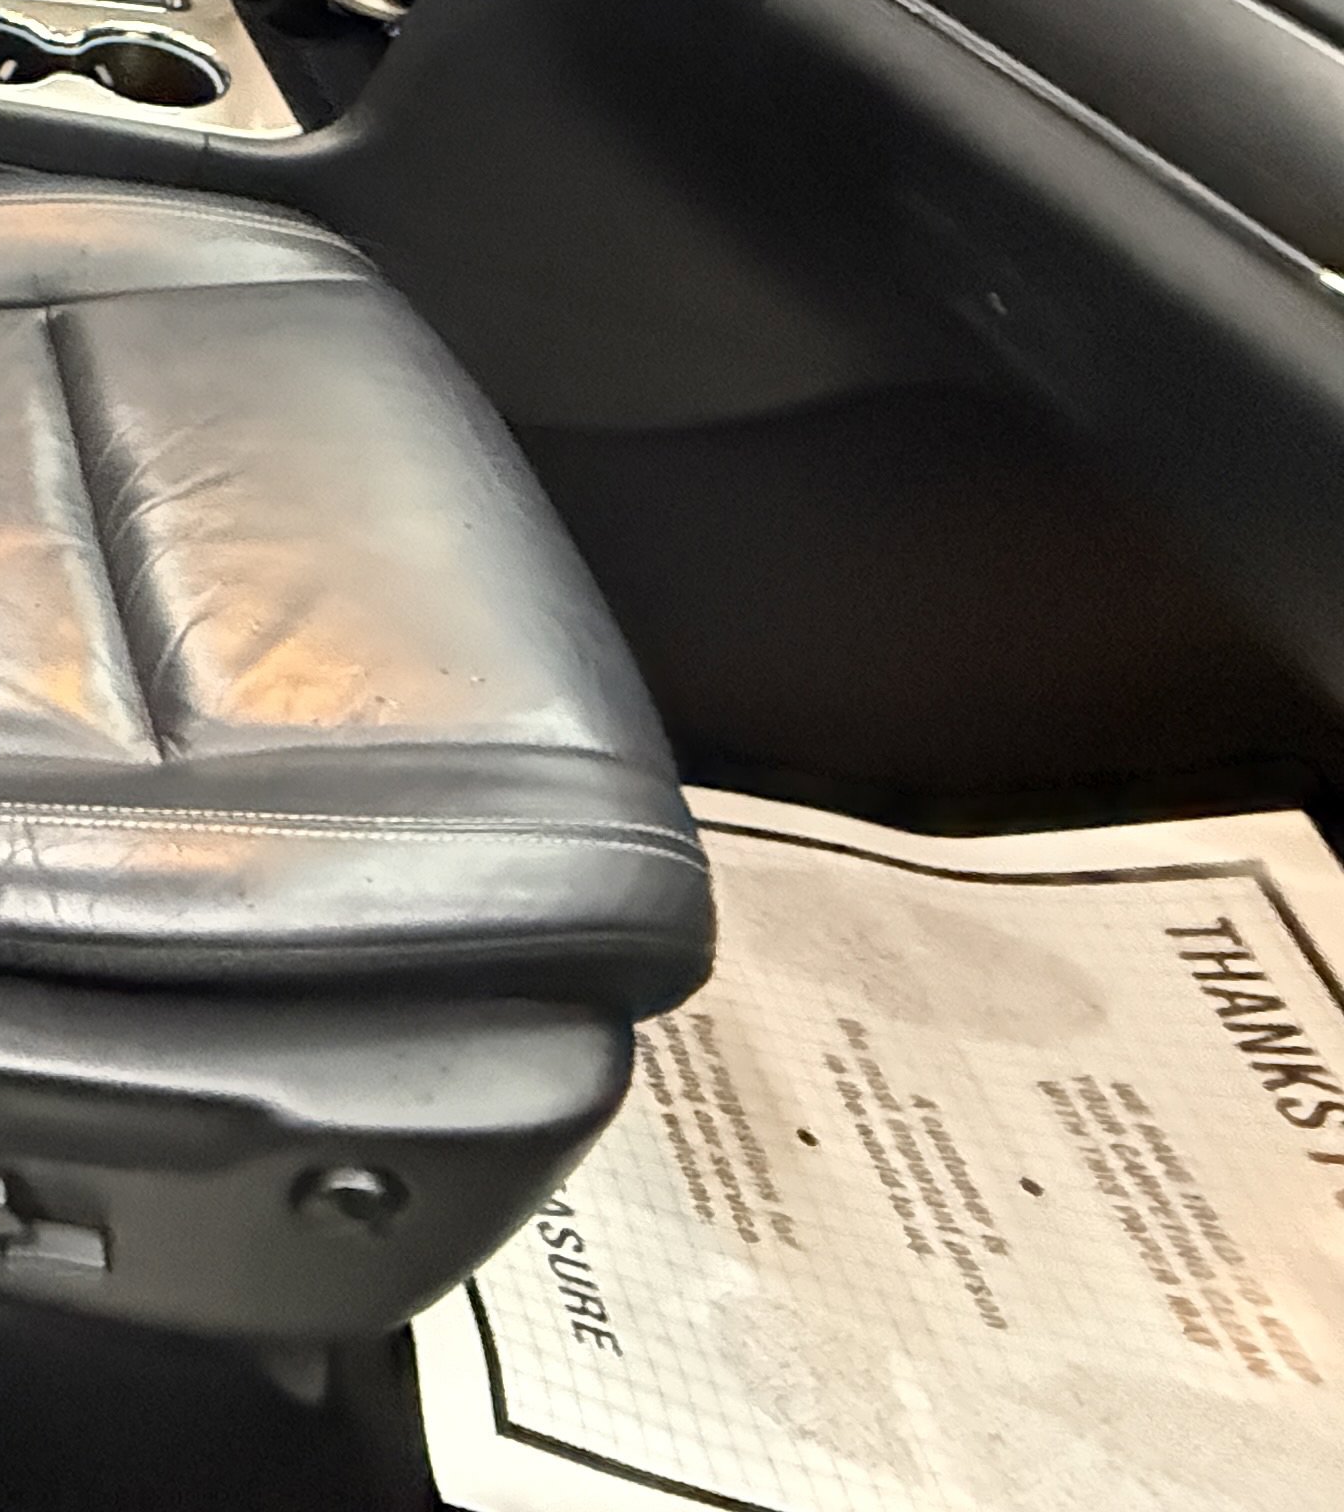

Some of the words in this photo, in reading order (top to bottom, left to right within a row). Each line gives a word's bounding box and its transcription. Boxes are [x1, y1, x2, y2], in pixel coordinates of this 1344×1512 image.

[1164, 917, 1344, 1129] THANKS
[694, 1110, 722, 1149] our
[711, 1154, 760, 1243] service
[709, 1064, 780, 1202] suggestions
[855, 1123, 907, 1188] world
[921, 1116, 994, 1227] customer
[534, 1179, 623, 1357] ASURE
[887, 1118, 964, 1235] important
[943, 1240, 1008, 1329] person
[1072, 1075, 1127, 1135] YOUR
[1200, 1288, 1276, 1377] CLEAN
